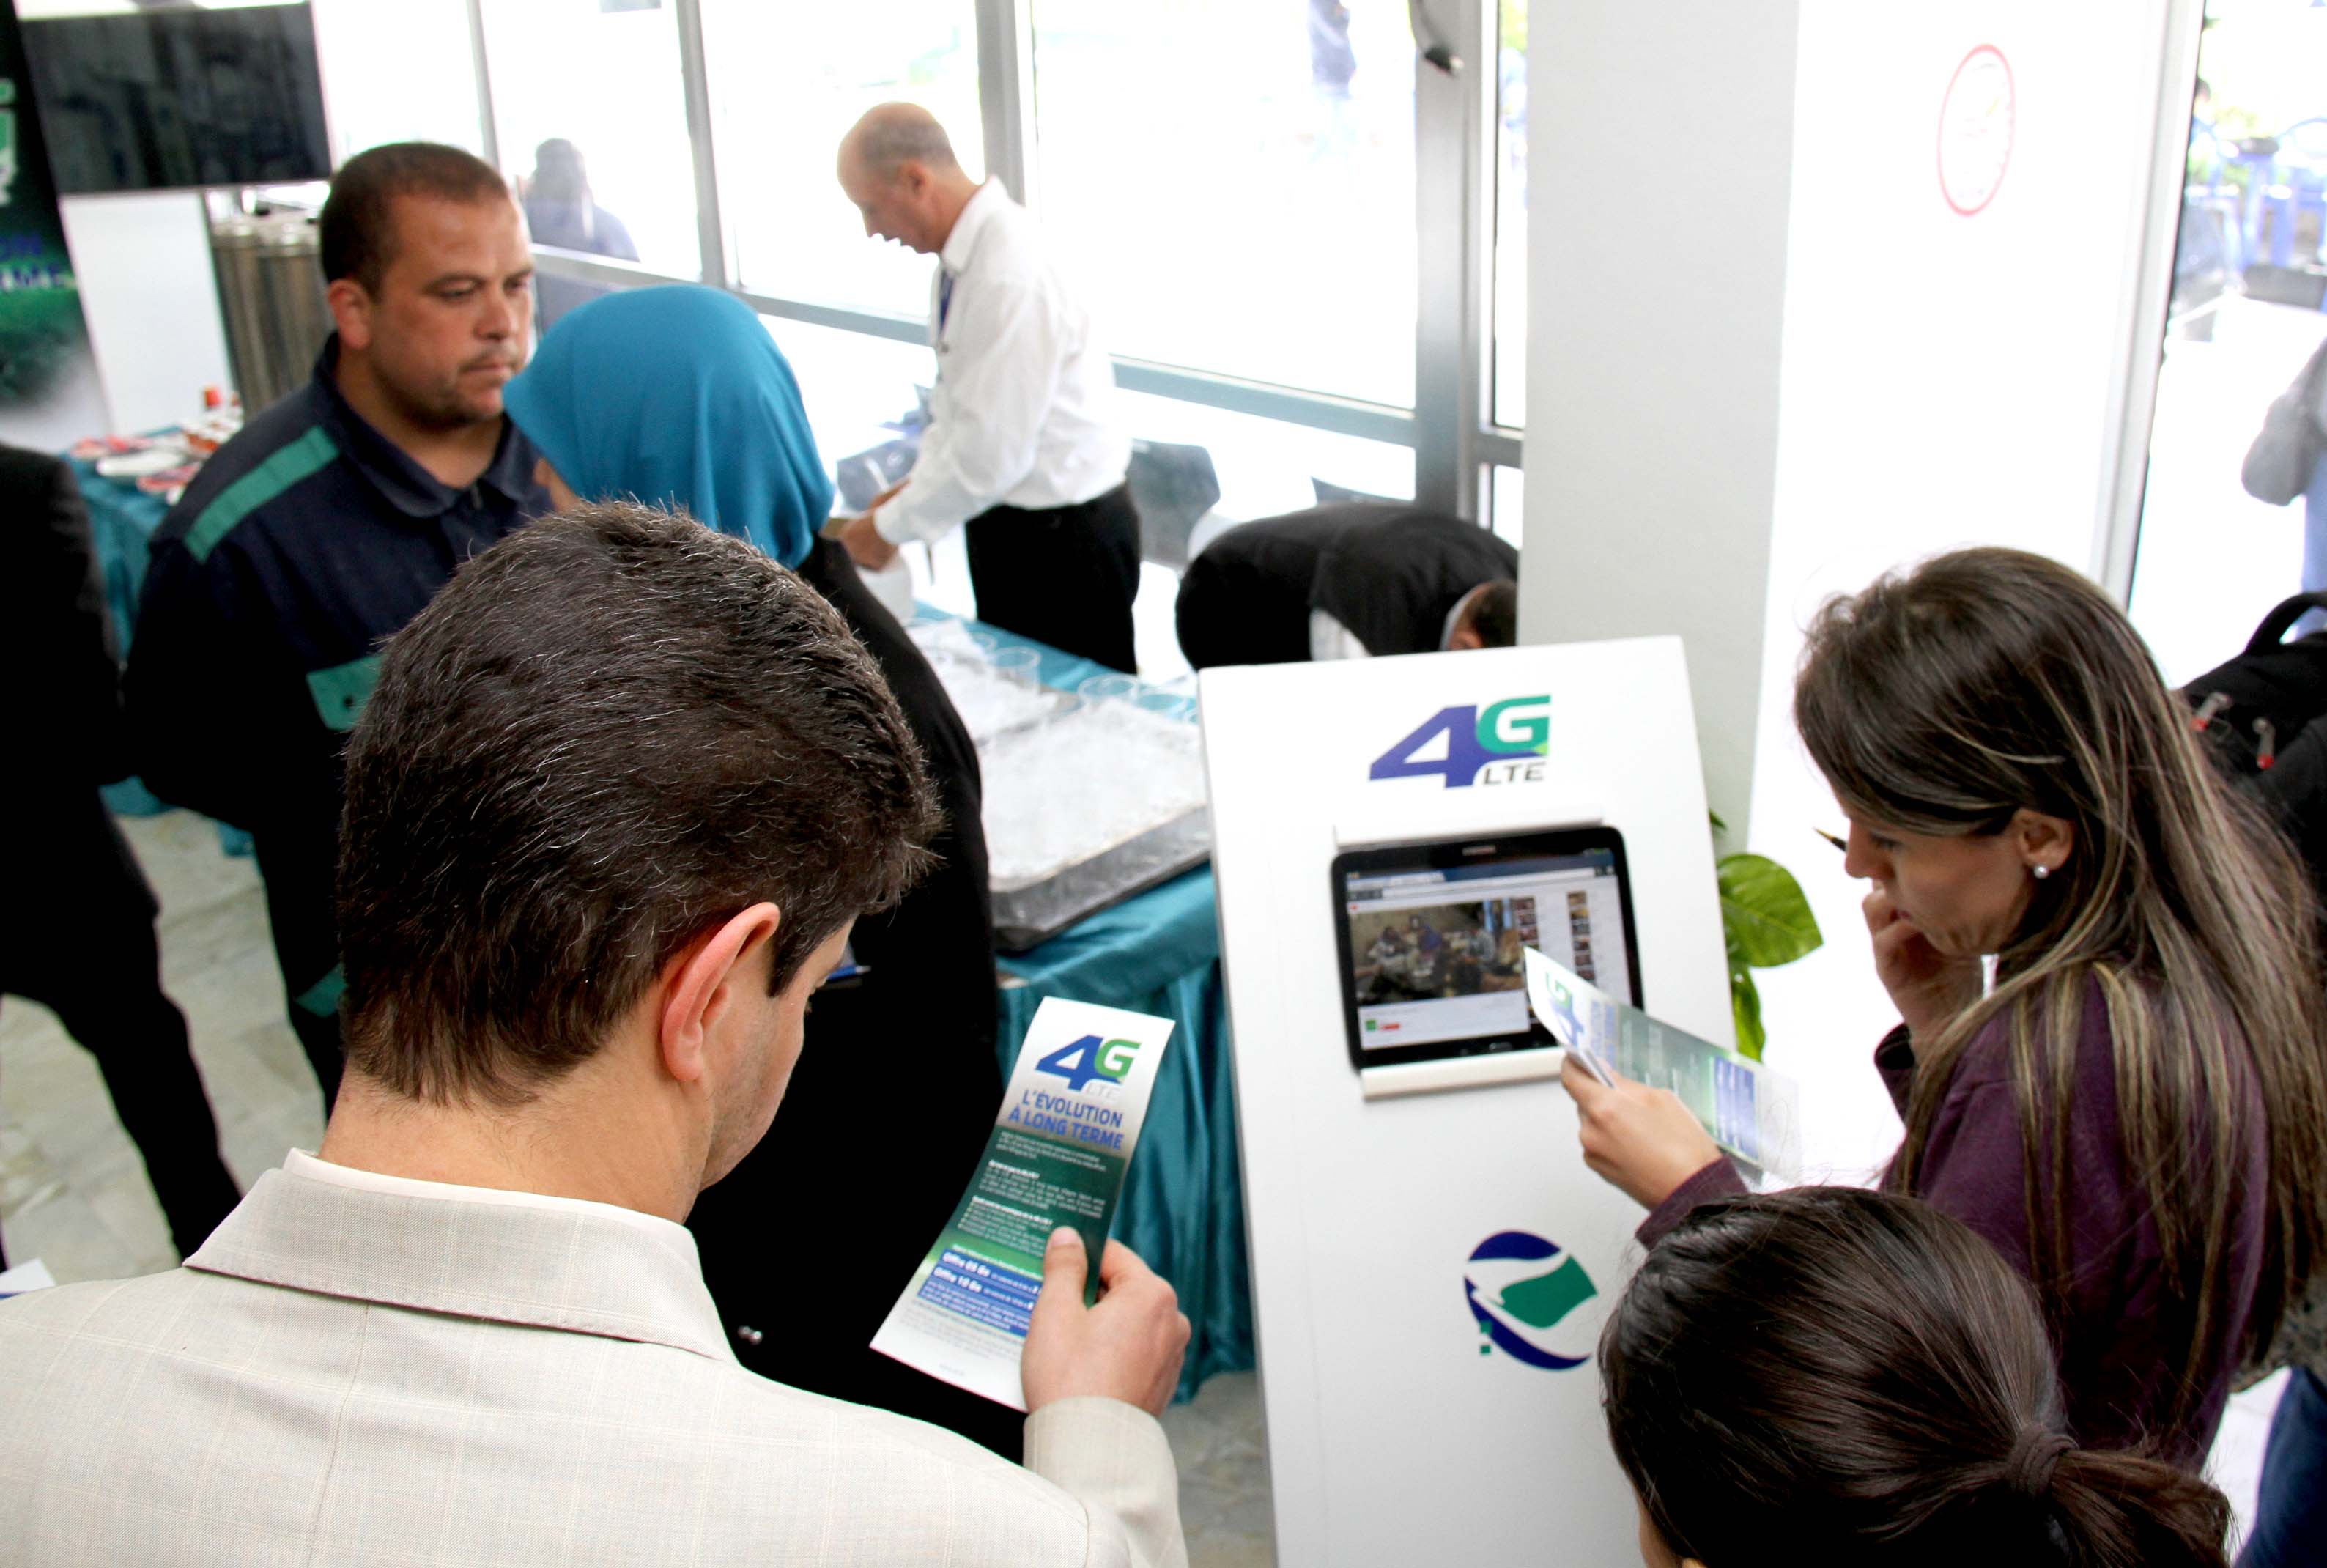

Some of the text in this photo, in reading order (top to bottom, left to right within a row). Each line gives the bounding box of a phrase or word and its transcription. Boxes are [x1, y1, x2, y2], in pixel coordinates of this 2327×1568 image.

[1369, 694, 1551, 788] 4G
[1482, 761, 1547, 785] LTE
[1035, 1035, 1142, 1092] 4G
[1022, 1089, 1123, 1128] L'ÉVOLUTION
[1023, 1110, 1068, 1136] LONG
[1071, 1122, 1125, 1150] TERME
